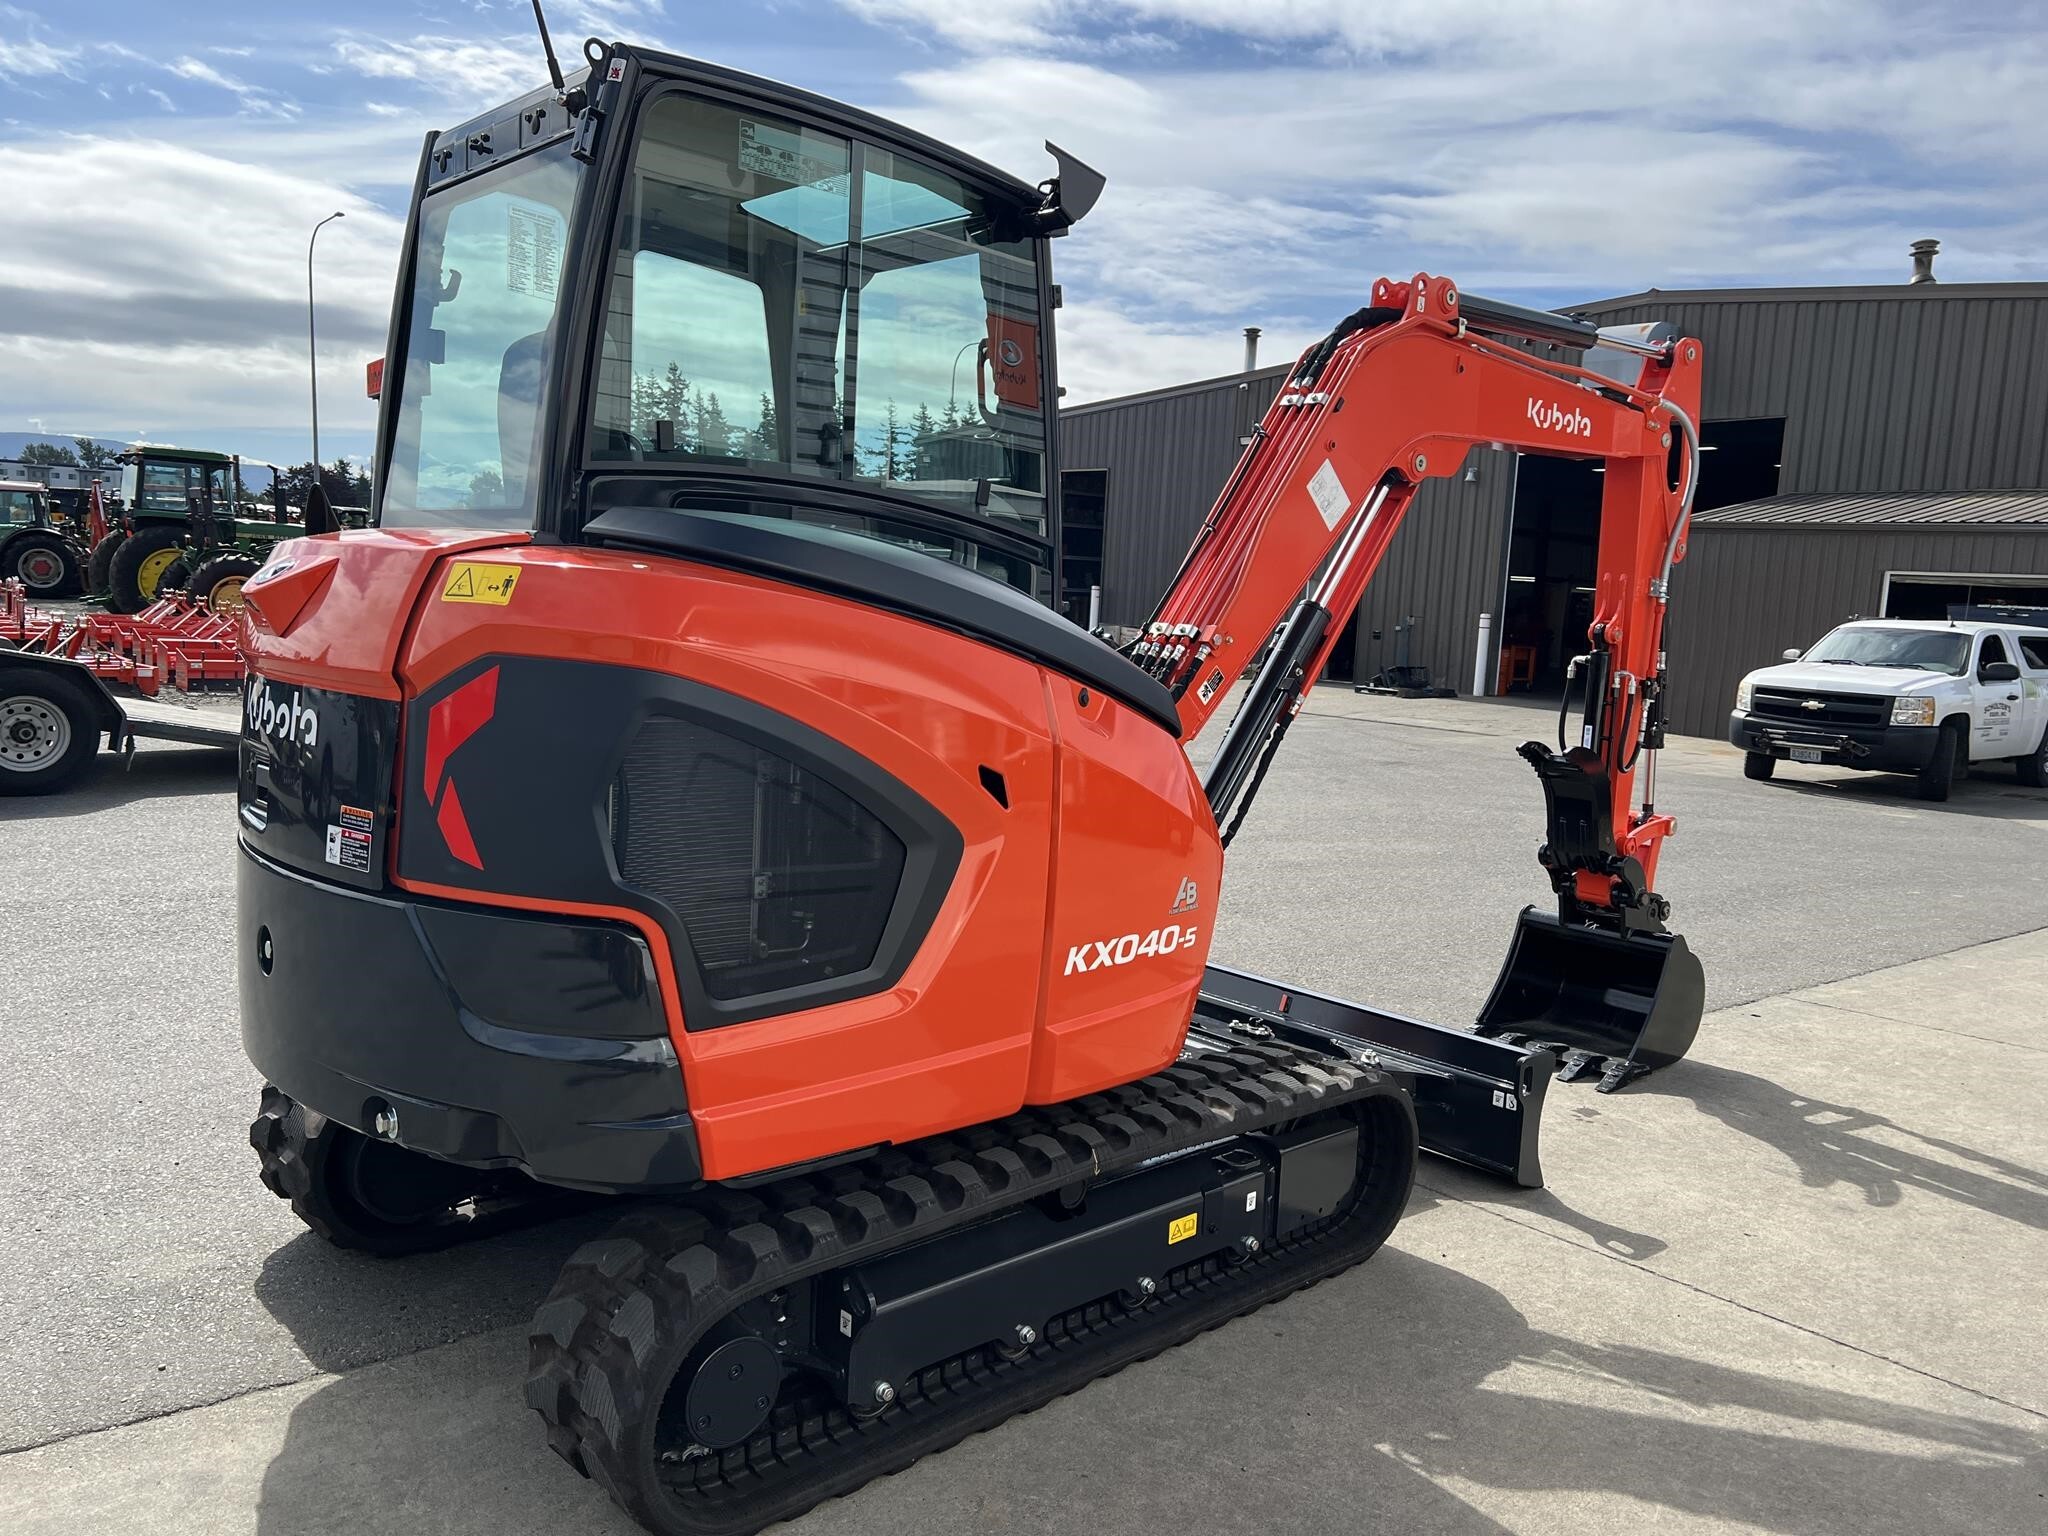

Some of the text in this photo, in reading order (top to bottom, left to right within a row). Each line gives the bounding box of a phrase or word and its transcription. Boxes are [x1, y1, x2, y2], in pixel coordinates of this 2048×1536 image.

[1527, 397, 1591, 437] Kubota
[247, 681, 317, 746] Kubota
[1173, 876, 1197, 909] AB
[1064, 925, 1197, 976] KX040-5
